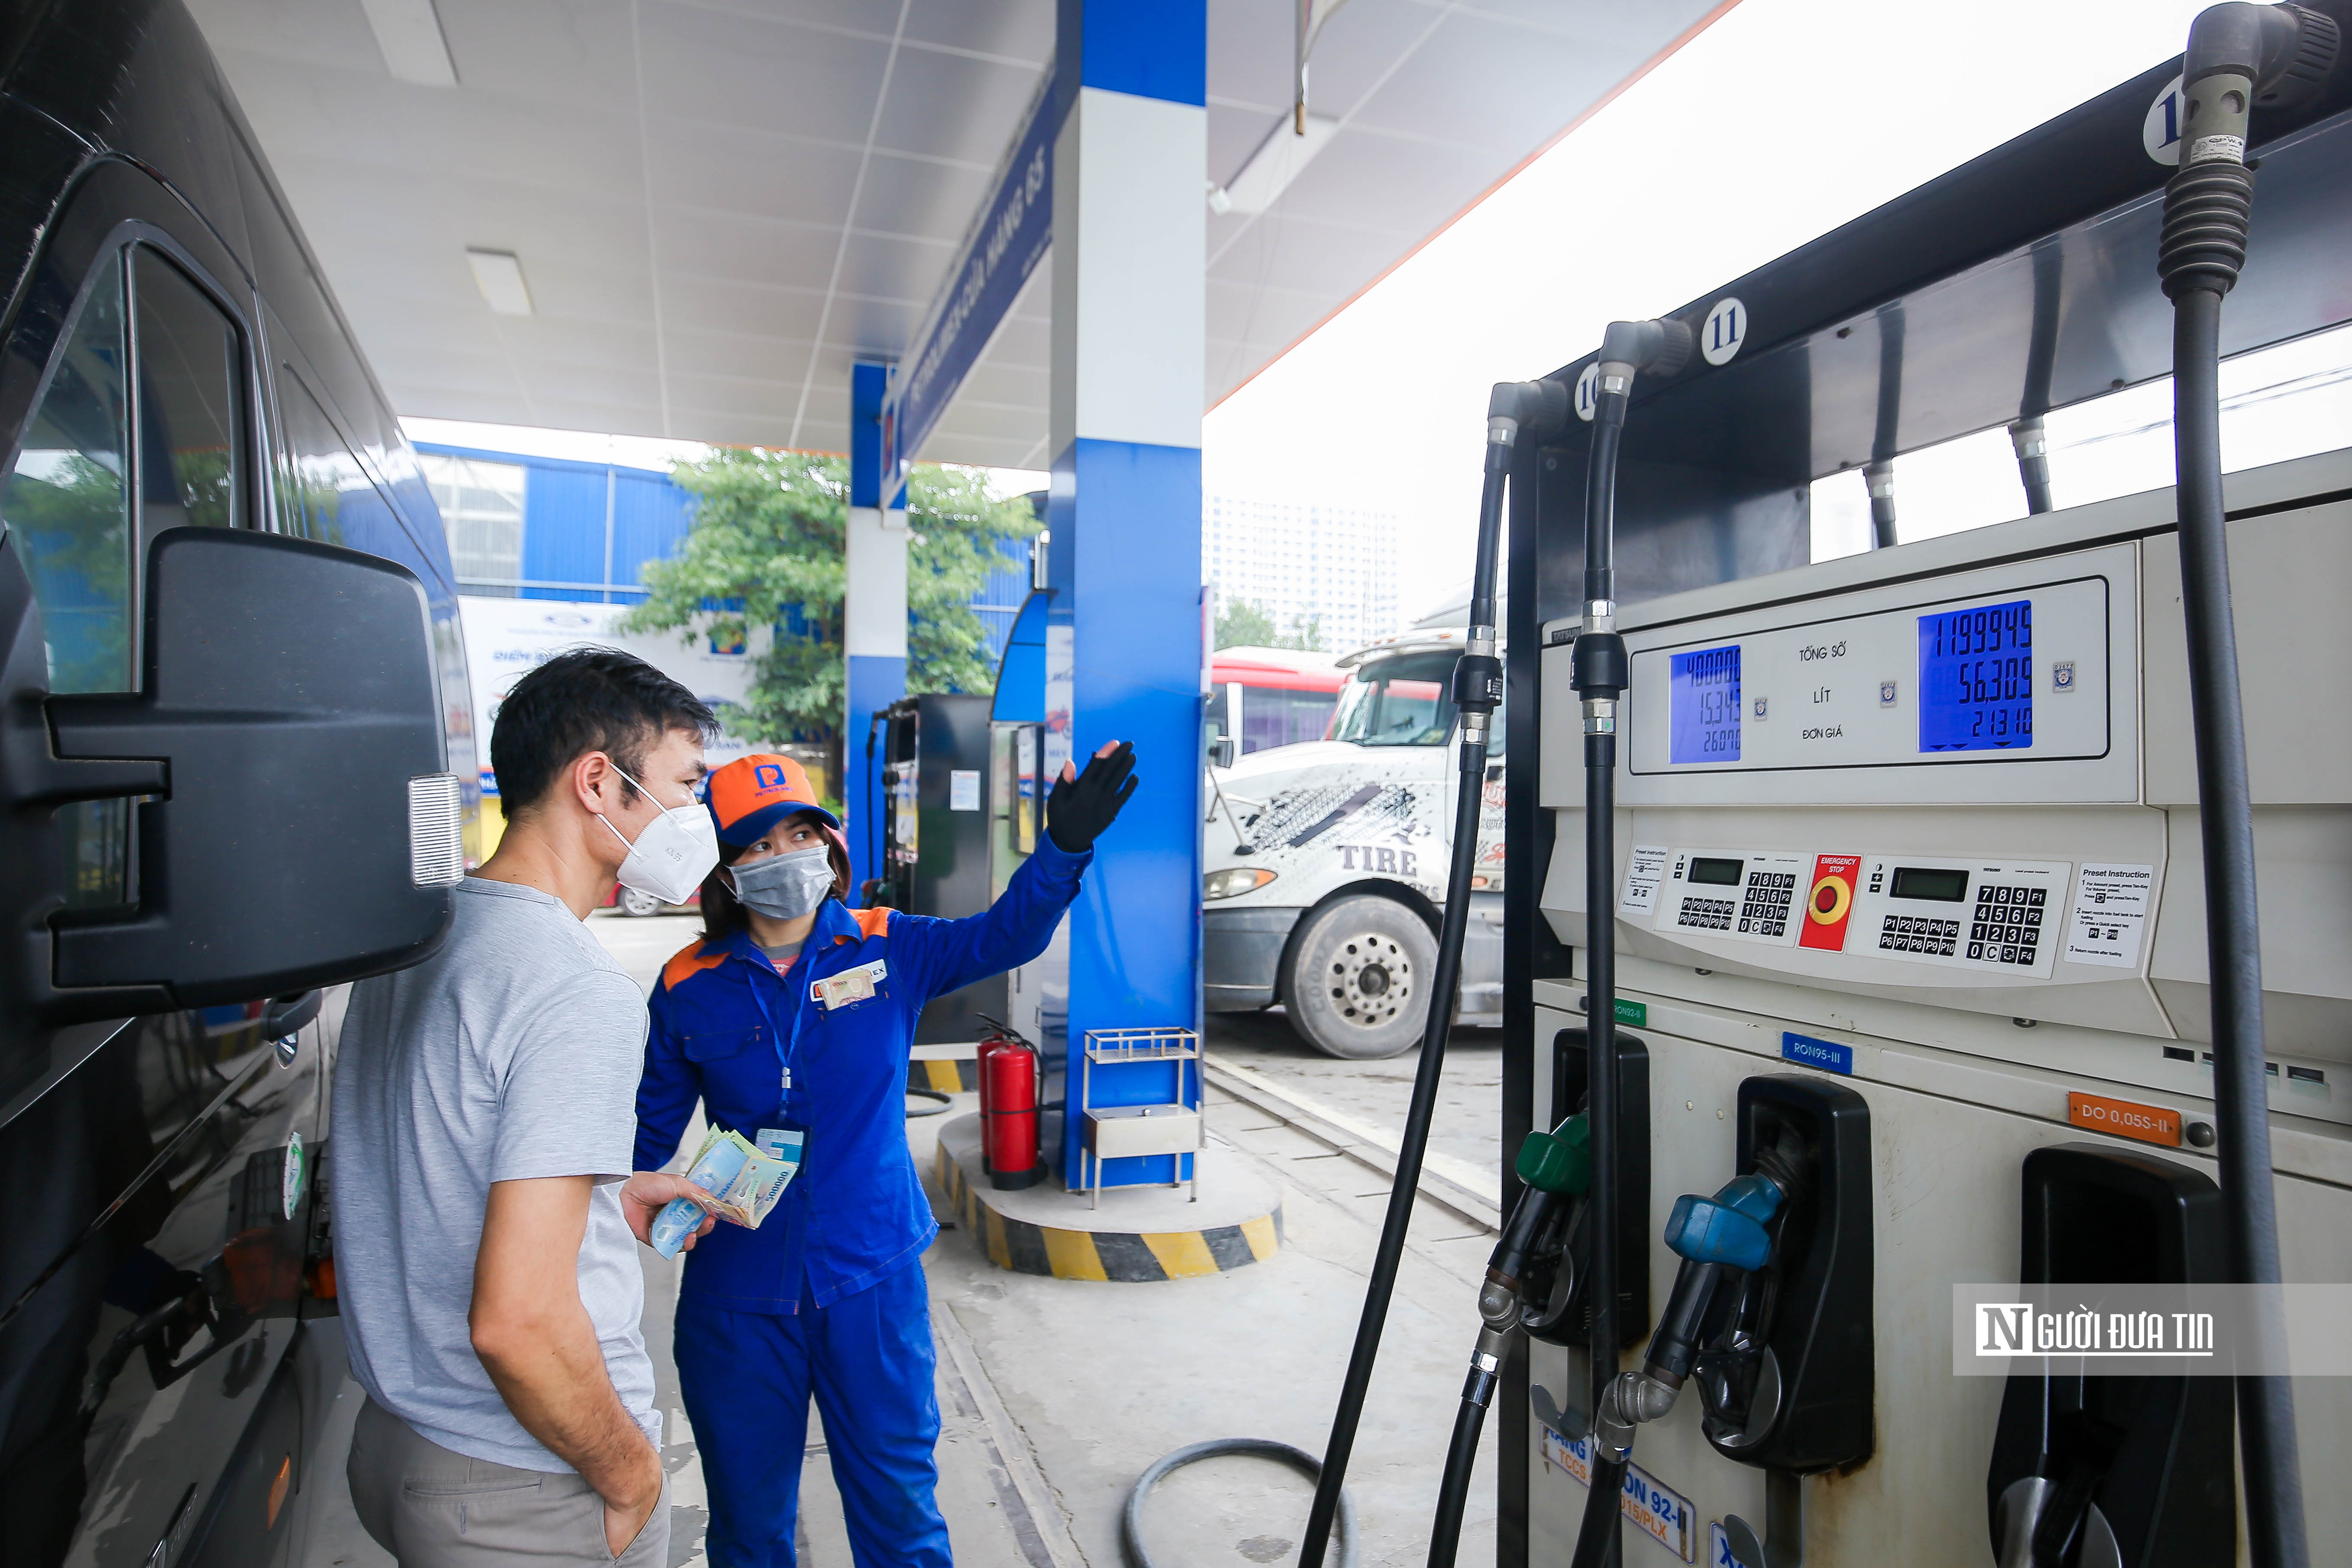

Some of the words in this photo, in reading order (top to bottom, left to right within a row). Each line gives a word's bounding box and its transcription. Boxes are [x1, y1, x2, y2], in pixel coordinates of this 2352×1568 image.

[2157, 90, 2181, 149] 1
[1710, 306, 1740, 353] 11
[1937, 605, 2032, 658] 1199945
[1800, 645, 1827, 662] TỔNG
[1832, 640, 1846, 657] SỐ
[1687, 649, 1741, 687] 400000
[1959, 656, 2032, 705] 56,309
[1813, 686, 1831, 703] LÍT
[1972, 707, 2032, 737] 21310
[1802, 728, 1823, 739] ĐƠN
[1825, 724, 1843, 738] GIÁ
[1704, 729, 1741, 752] 26070
[1337, 846, 1417, 877] TIRE
[1821, 857, 1857, 866] EMERGENCY
[1752, 874, 1758, 884] 7
[1763, 875, 1768, 885] 8
[1775, 876, 1780, 886] 9
[2108, 870, 2150, 879] Instruction
[1748, 890, 1754, 899] 4
[1759, 891, 1766, 900] 5
[1771, 892, 1777, 901] 6
[1983, 889, 1991, 899] 7
[1999, 890, 2007, 901] 8
[2016, 890, 2024, 902] 9
[1746, 905, 1750, 915] 1
[1755, 906, 1762, 916] 2
[1768, 907, 1773, 917] 3
[1978, 907, 1986, 919] 4
[1995, 909, 2003, 920] 5
[2013, 910, 2020, 922] 6
[2028, 913, 2039, 921] F2
[1741, 921, 1747, 930] 0
[1751, 922, 1759, 932] C
[1885, 919, 1895, 928] P1
[1900, 920, 1911, 929] P2
[1915, 922, 1926, 931] P3
[1930, 923, 1941, 932] P4
[1945, 925, 1957, 934] P5
[1976, 926, 1982, 938] 1
[1991, 928, 1999, 939] 2
[2008, 929, 2016, 941] 3
[2025, 932, 2035, 941] F3
[1882, 937, 1892, 945] P6
[1896, 938, 1908, 947] P7
[1911, 940, 1922, 949] P8
[1926, 941, 1937, 951] P9
[1940, 943, 1954, 952] P10
[1971, 945, 1979, 957] 0
[1987, 946, 1997, 958] C
[2021, 952, 2031, 960] F4
[1794, 1042, 1840, 1064] RON95-III
[2082, 1104, 2105, 1120] DO
[2110, 1110, 2167, 1133] 0,05S-II
[765, 1171, 788, 1203] 500000
[1558, 1448, 1586, 1480] TCCS
